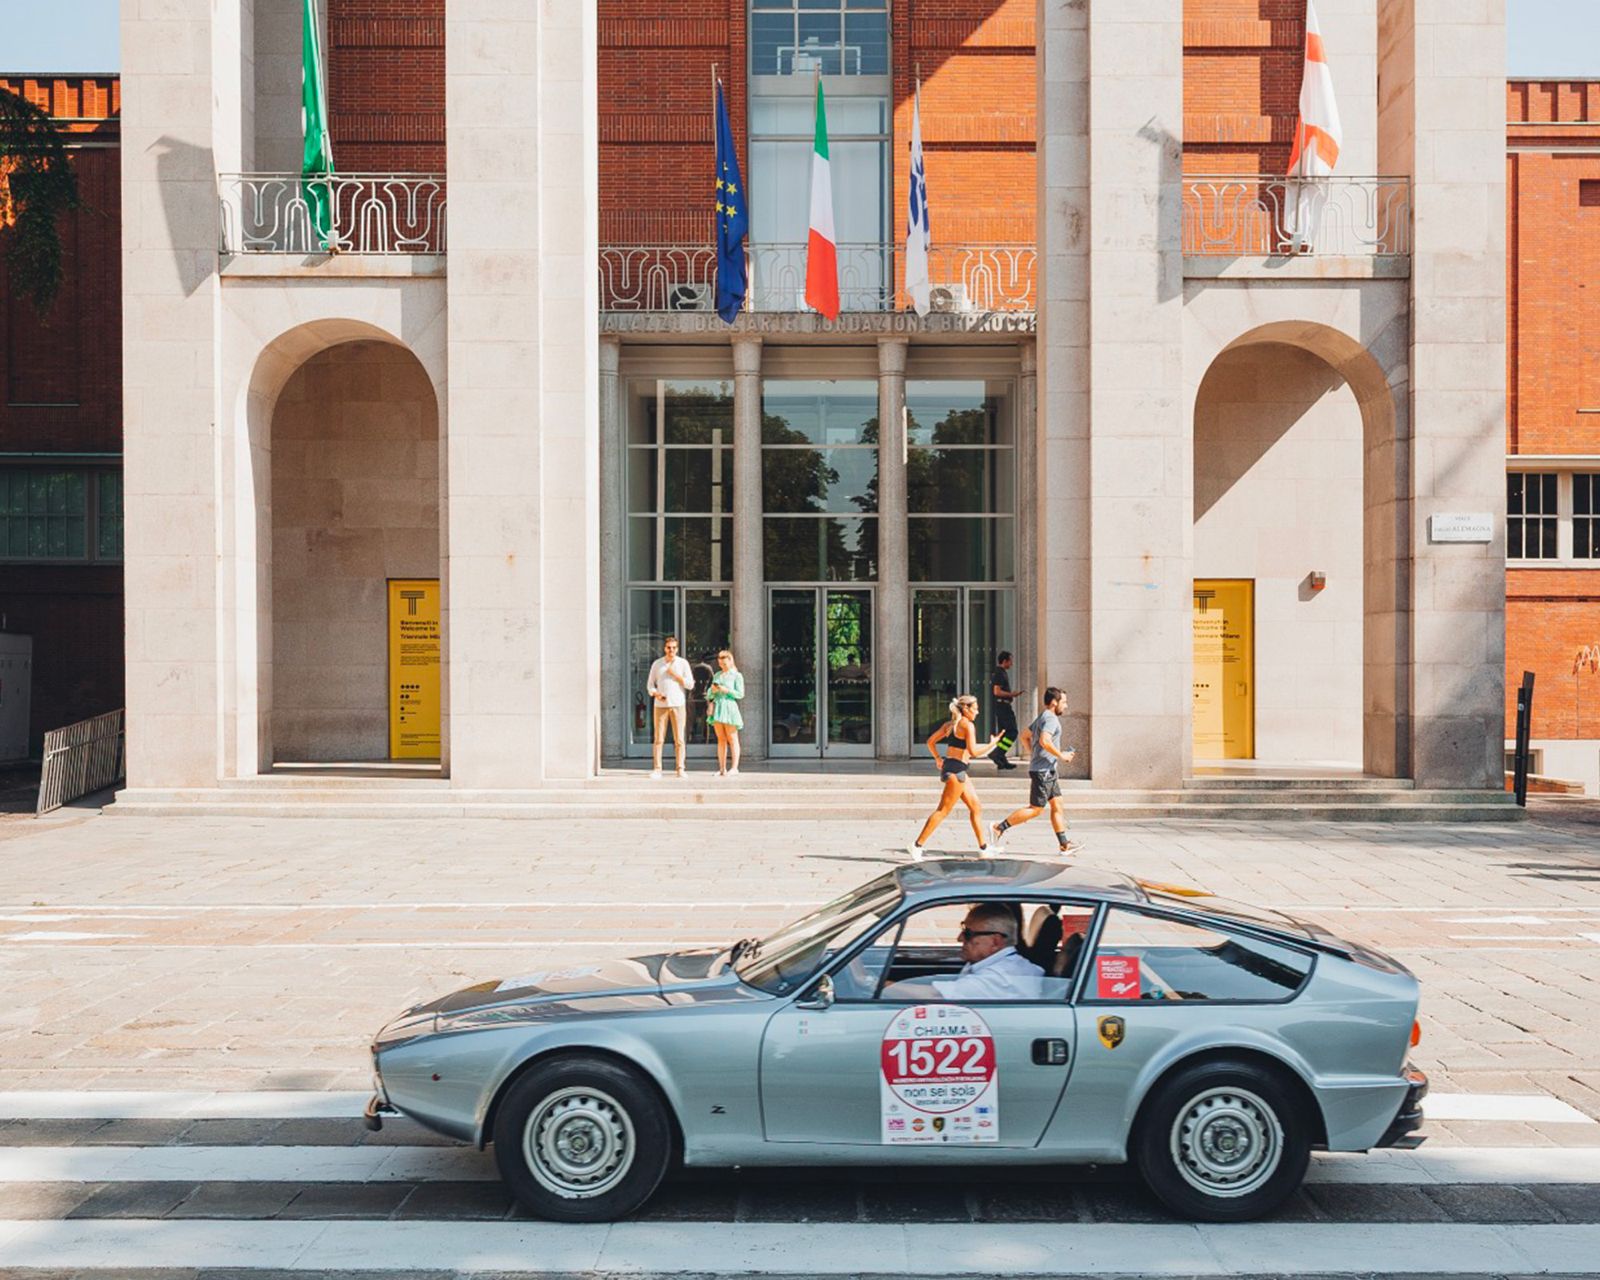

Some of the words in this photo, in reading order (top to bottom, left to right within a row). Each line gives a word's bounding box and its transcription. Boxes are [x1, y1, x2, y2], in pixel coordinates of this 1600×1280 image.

[603, 314, 682, 333] ALAZZO
[914, 1026, 969, 1036] CHIAMA
[888, 1039, 987, 1076] 1522
[903, 1087, 928, 1098] non
[929, 1085, 949, 1097] sei
[951, 1084, 976, 1096] sola
